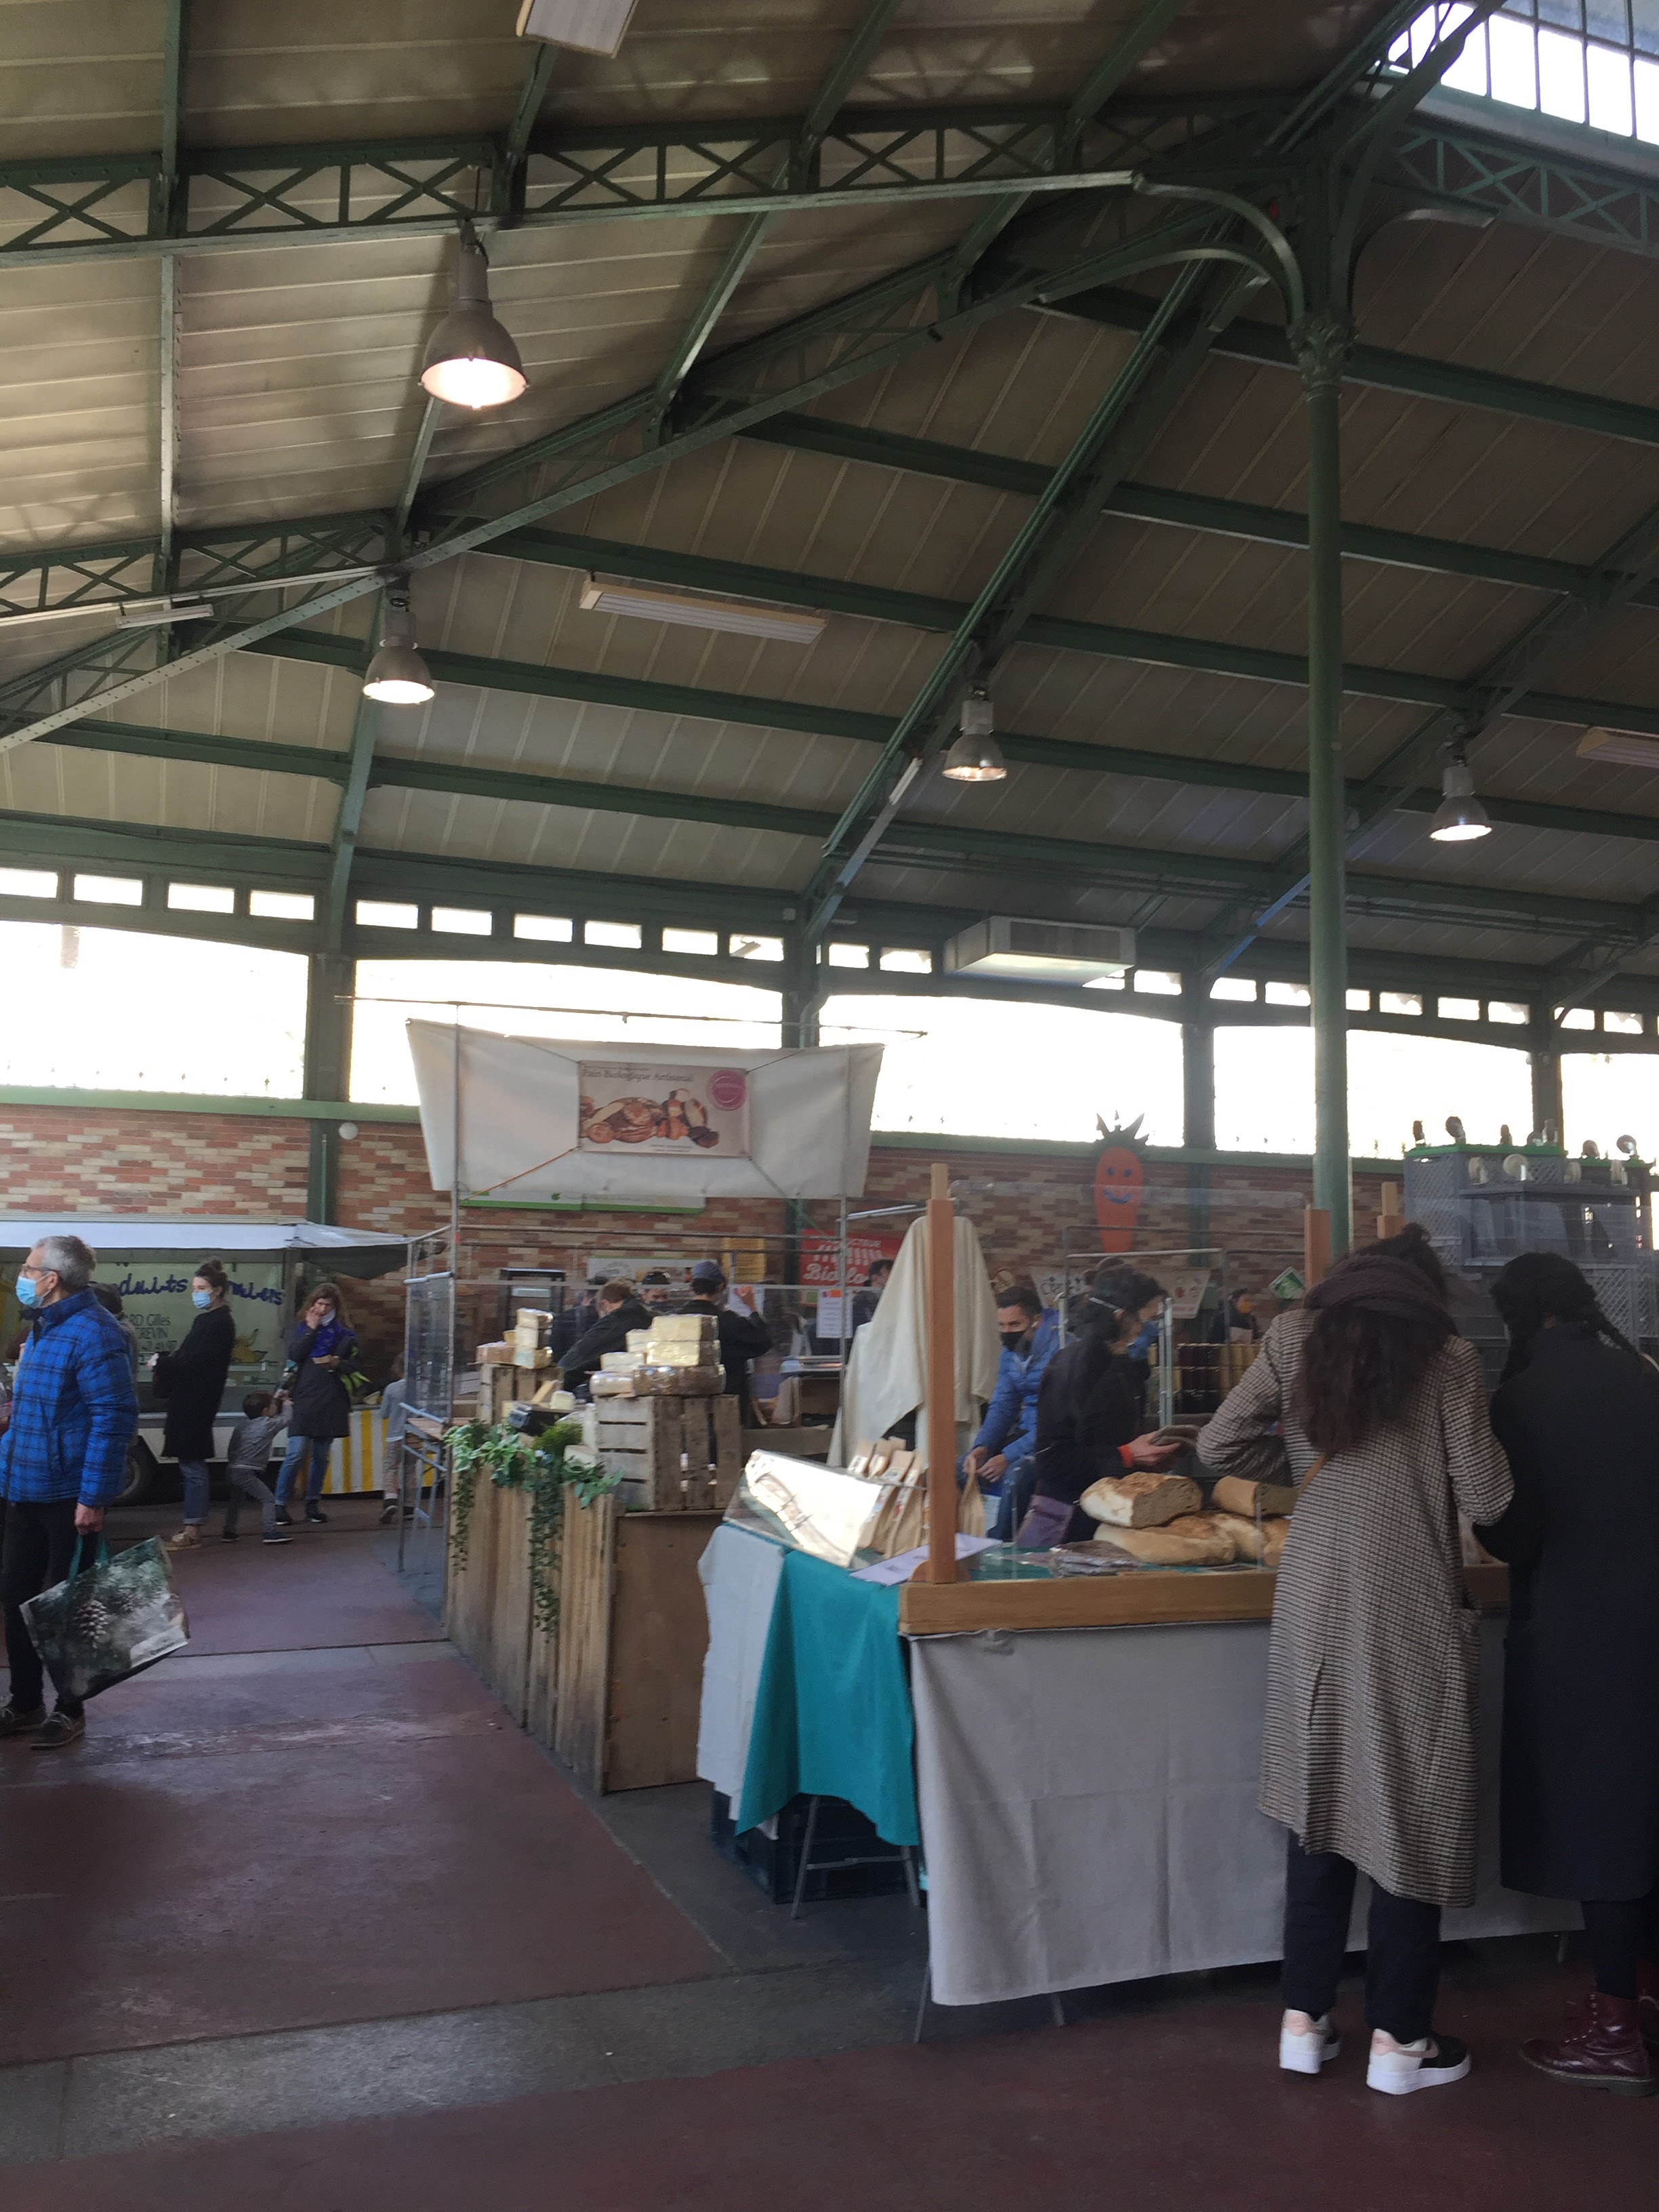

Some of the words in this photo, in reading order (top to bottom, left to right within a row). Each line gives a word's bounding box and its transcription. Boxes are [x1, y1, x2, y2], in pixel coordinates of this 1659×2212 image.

[582, 1069, 601, 1078] Pain
[604, 1070, 651, 1082] Biologique
[653, 1073, 694, 1082] Artisanal
[118, 1272, 189, 1296] duits
